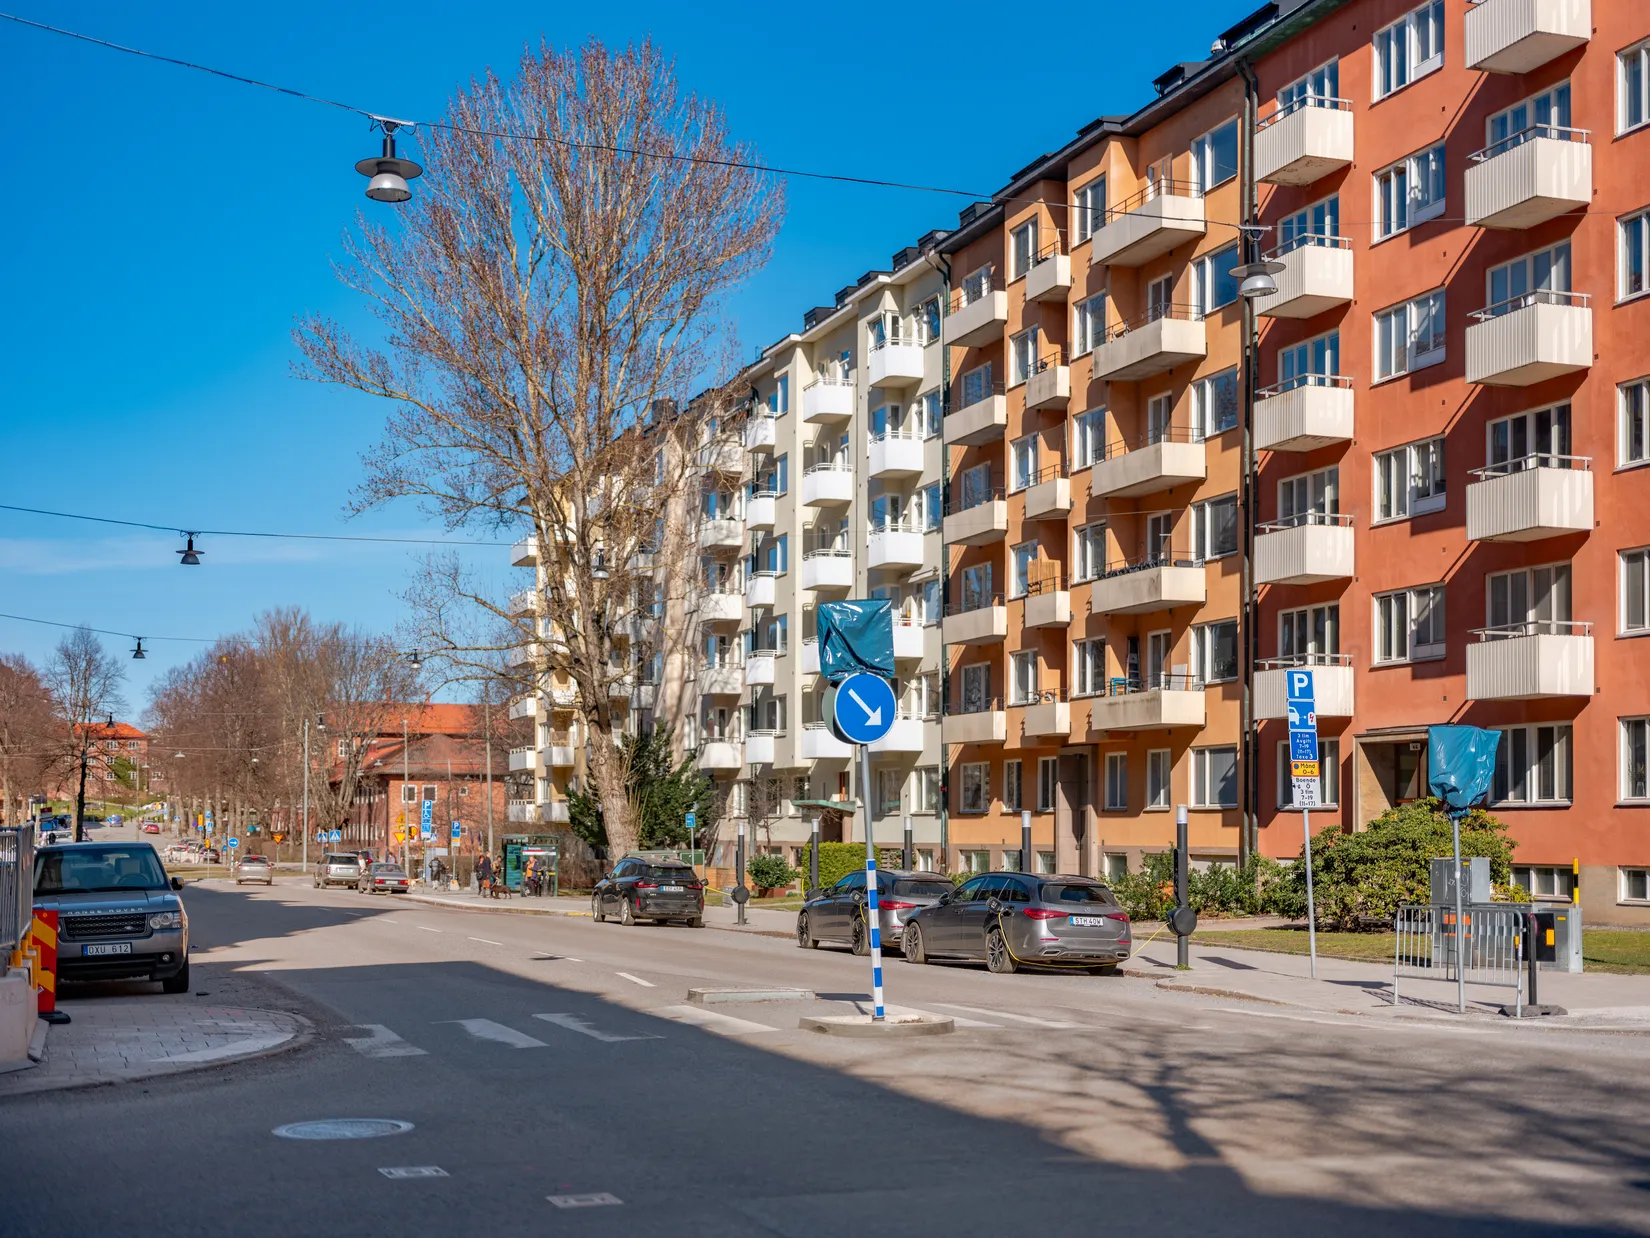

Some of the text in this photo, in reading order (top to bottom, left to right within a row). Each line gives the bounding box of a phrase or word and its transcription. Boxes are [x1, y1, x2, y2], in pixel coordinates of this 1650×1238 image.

[1294, 674, 1308, 696] P
[89, 945, 129, 954] OXU 612
